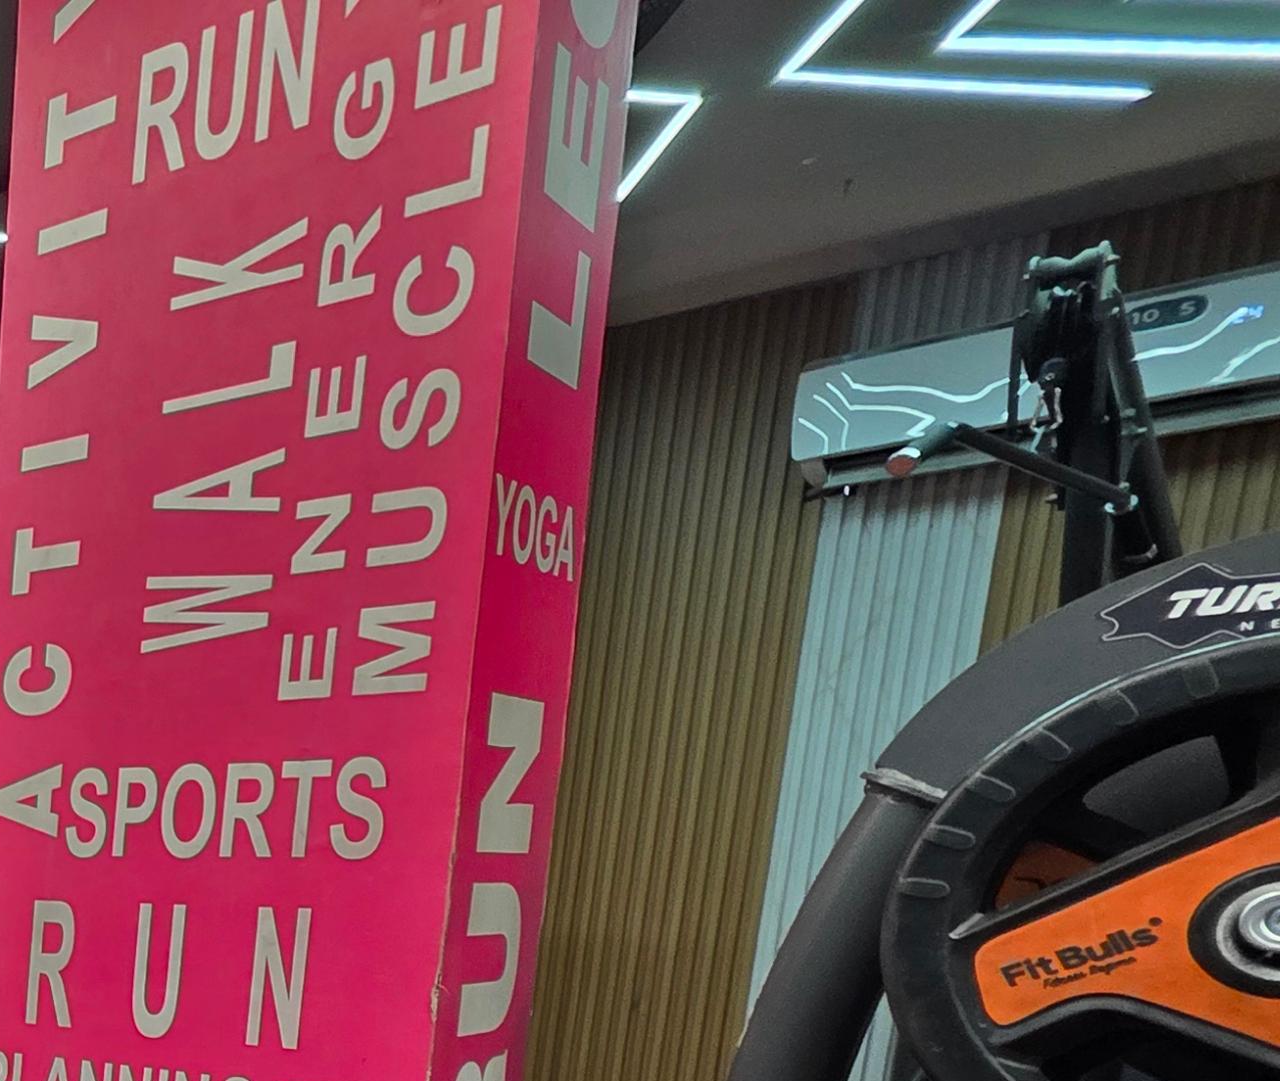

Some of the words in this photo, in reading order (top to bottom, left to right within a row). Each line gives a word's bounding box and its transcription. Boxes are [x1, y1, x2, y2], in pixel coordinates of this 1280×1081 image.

[131, 0, 320, 185] RUN
[277, 0, 397, 702] ENERG
[352, 4, 504, 696] MUSCLE
[140, 217, 309, 654] WALK
[494, 472, 575, 583] YOGA
[1167, 582, 1280, 619] TUR
[64, 756, 388, 860] SPORTS
[25, 899, 313, 1051] RUN
[999, 956, 1060, 988] Fit
[1054, 927, 1160, 971] Bulls
